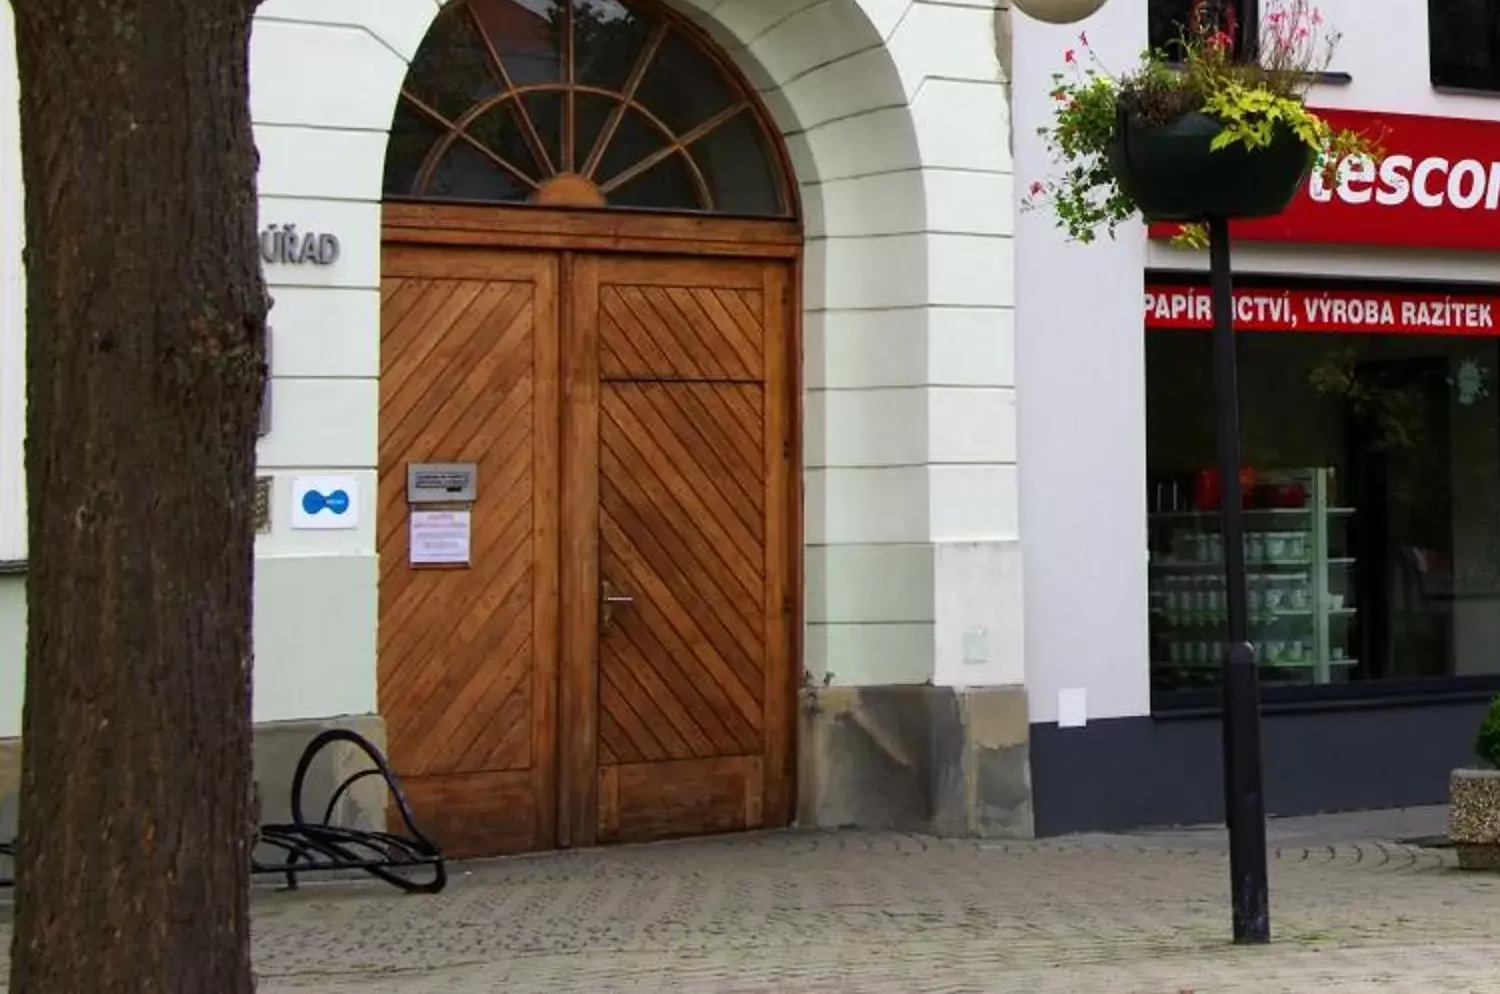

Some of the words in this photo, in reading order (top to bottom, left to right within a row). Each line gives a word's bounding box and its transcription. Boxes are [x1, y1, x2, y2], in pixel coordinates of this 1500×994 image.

[261, 223, 341, 265] ÚŘAD
[1143, 287, 1297, 328] PAPÍRICTVÍ,
[1304, 291, 1395, 325] VÝROBA
[1401, 295, 1493, 328] RAZÍTEK
